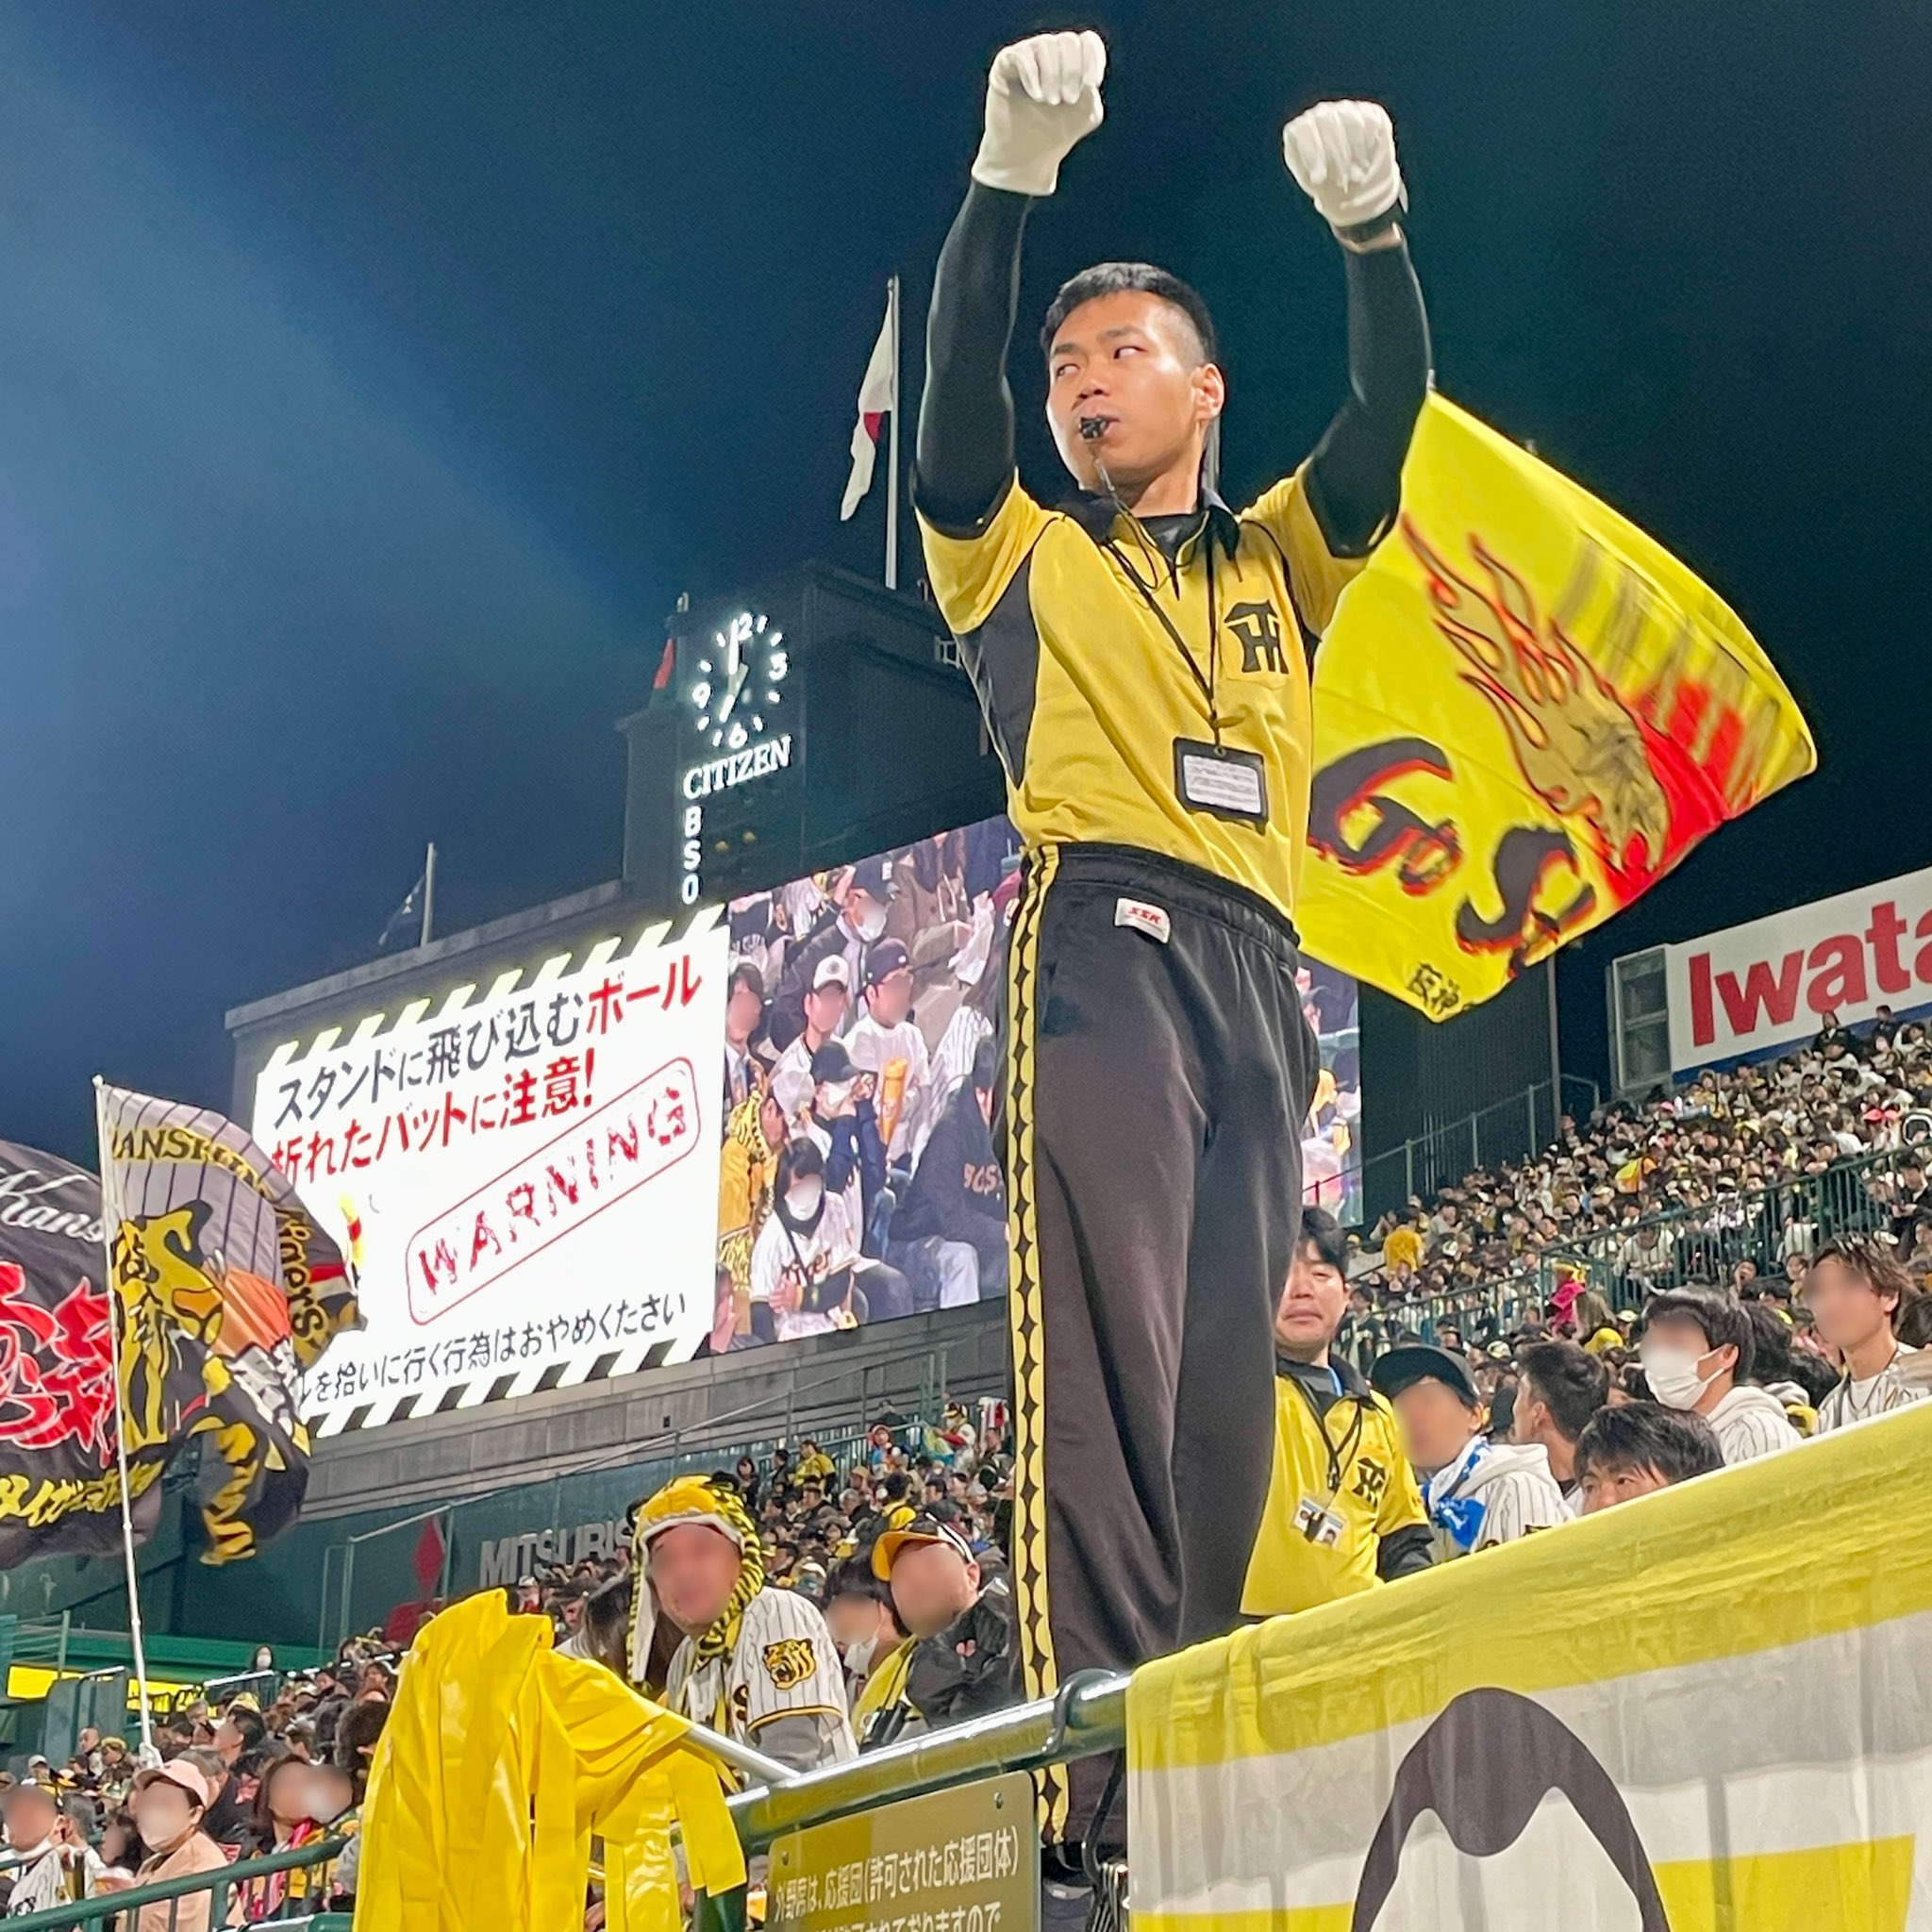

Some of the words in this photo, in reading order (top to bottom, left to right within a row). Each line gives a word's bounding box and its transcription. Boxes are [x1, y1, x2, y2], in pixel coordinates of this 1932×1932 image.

[683, 735, 792, 800] CITIZEN
[274, 954, 703, 1129] スタンドに飛び込むボール
[418, 1086, 687, 1296] WARNING
